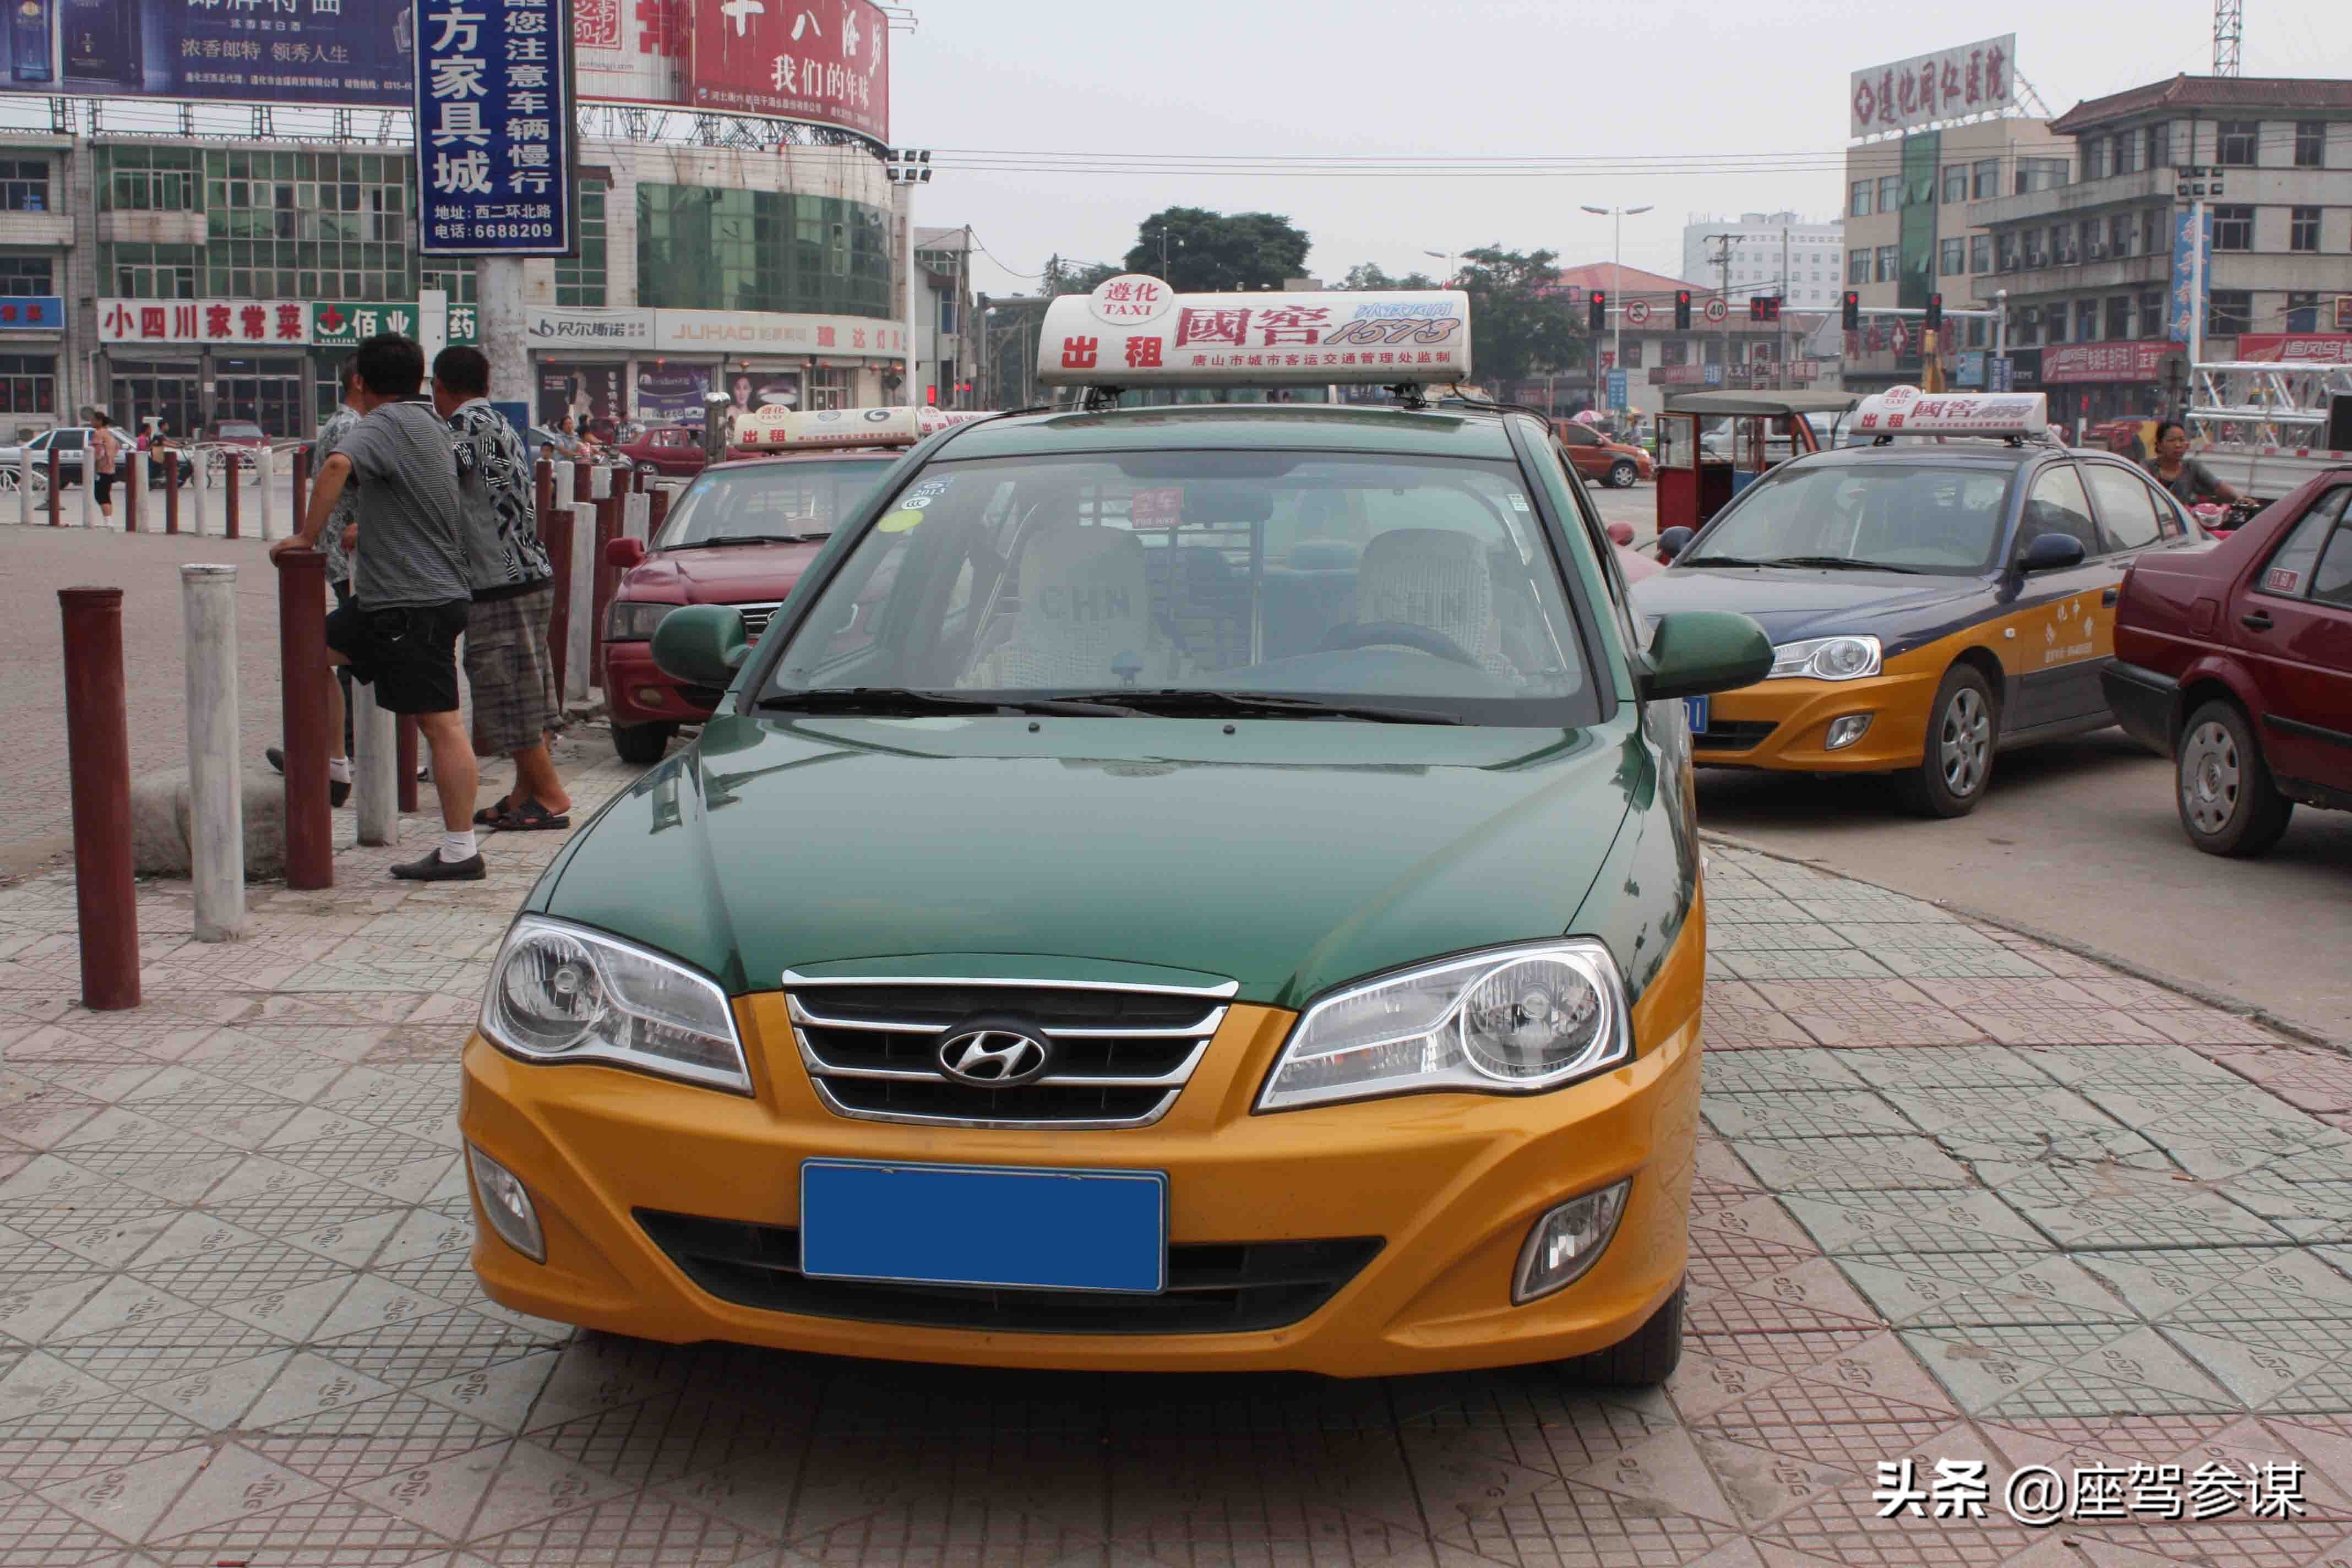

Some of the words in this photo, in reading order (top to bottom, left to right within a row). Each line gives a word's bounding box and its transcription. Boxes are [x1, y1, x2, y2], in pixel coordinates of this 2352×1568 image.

[182, 39, 261, 61] 浓香郎特
[271, 42, 350, 63] 领秀人生
[771, 54, 869, 110] 我们的年味
[428, 0, 493, 193] 方家具城
[434, 224, 552, 238] 电话:6688209
[1104, 282, 1159, 302] 遵化
[1103, 304, 1152, 316] TAXI
[1709, 304, 1724, 316] 40
[104, 303, 301, 340] 小四川家常菜
[557, 321, 625, 337] 贝尔斯诺
[671, 324, 754, 340] JUHAO
[1323, 318, 1461, 345] 1573
[1061, 335, 1163, 368] 出租
[1191, 351, 1450, 367] 唐山市城市客运交通管理处监制
[1861, 413, 1905, 428] 出租
[743, 429, 786, 443] 出租
